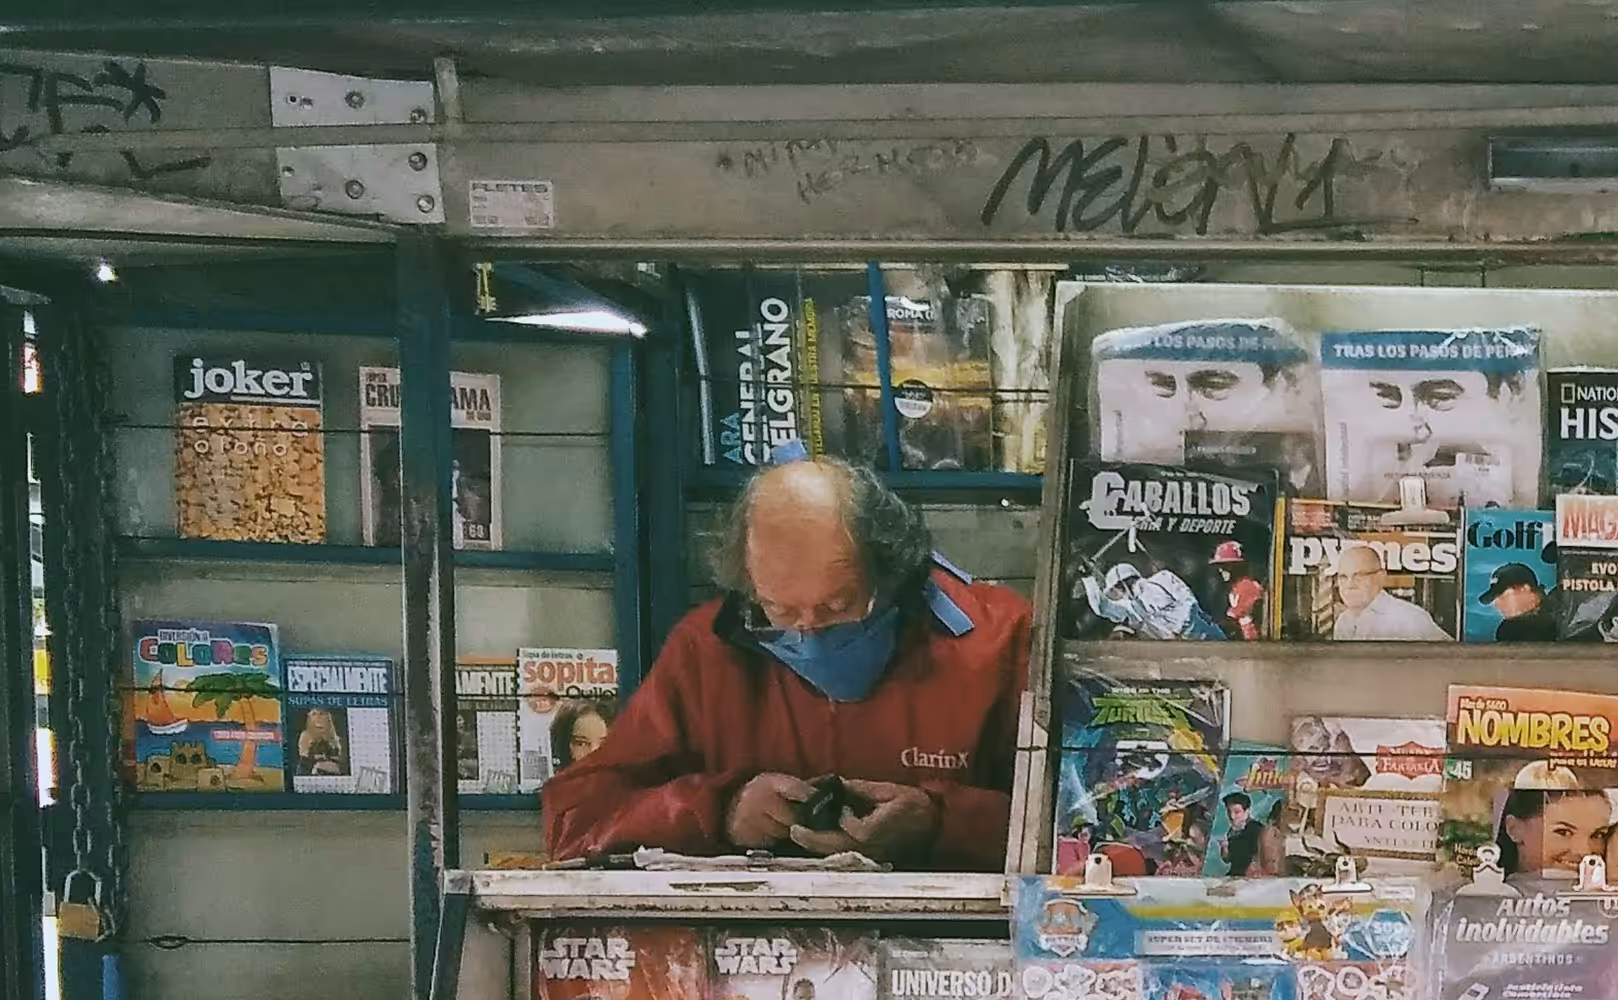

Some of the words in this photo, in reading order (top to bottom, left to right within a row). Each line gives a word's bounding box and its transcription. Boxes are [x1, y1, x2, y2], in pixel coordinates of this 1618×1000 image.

[1334, 343, 1375, 358] TRAS
[1378, 344, 1407, 359] LOS
[185, 359, 312, 399] joker
[1180, 519, 1236, 534] DEPORTE
[1468, 520, 1542, 550] Golf
[1563, 580, 1616, 591] PISTOLA
[523, 657, 615, 686] sopita
[1457, 710, 1609, 751] NOMBRES
[901, 748, 955, 768] Clarín
[1498, 898, 1570, 918] Autos
[1456, 918, 1609, 945] inolvidables
[553, 938, 635, 958] STAR
[723, 938, 797, 957] STAR
[541, 951, 636, 980] WARS
[715, 950, 798, 975] WARS
[892, 970, 989, 996] UNIVERSO
